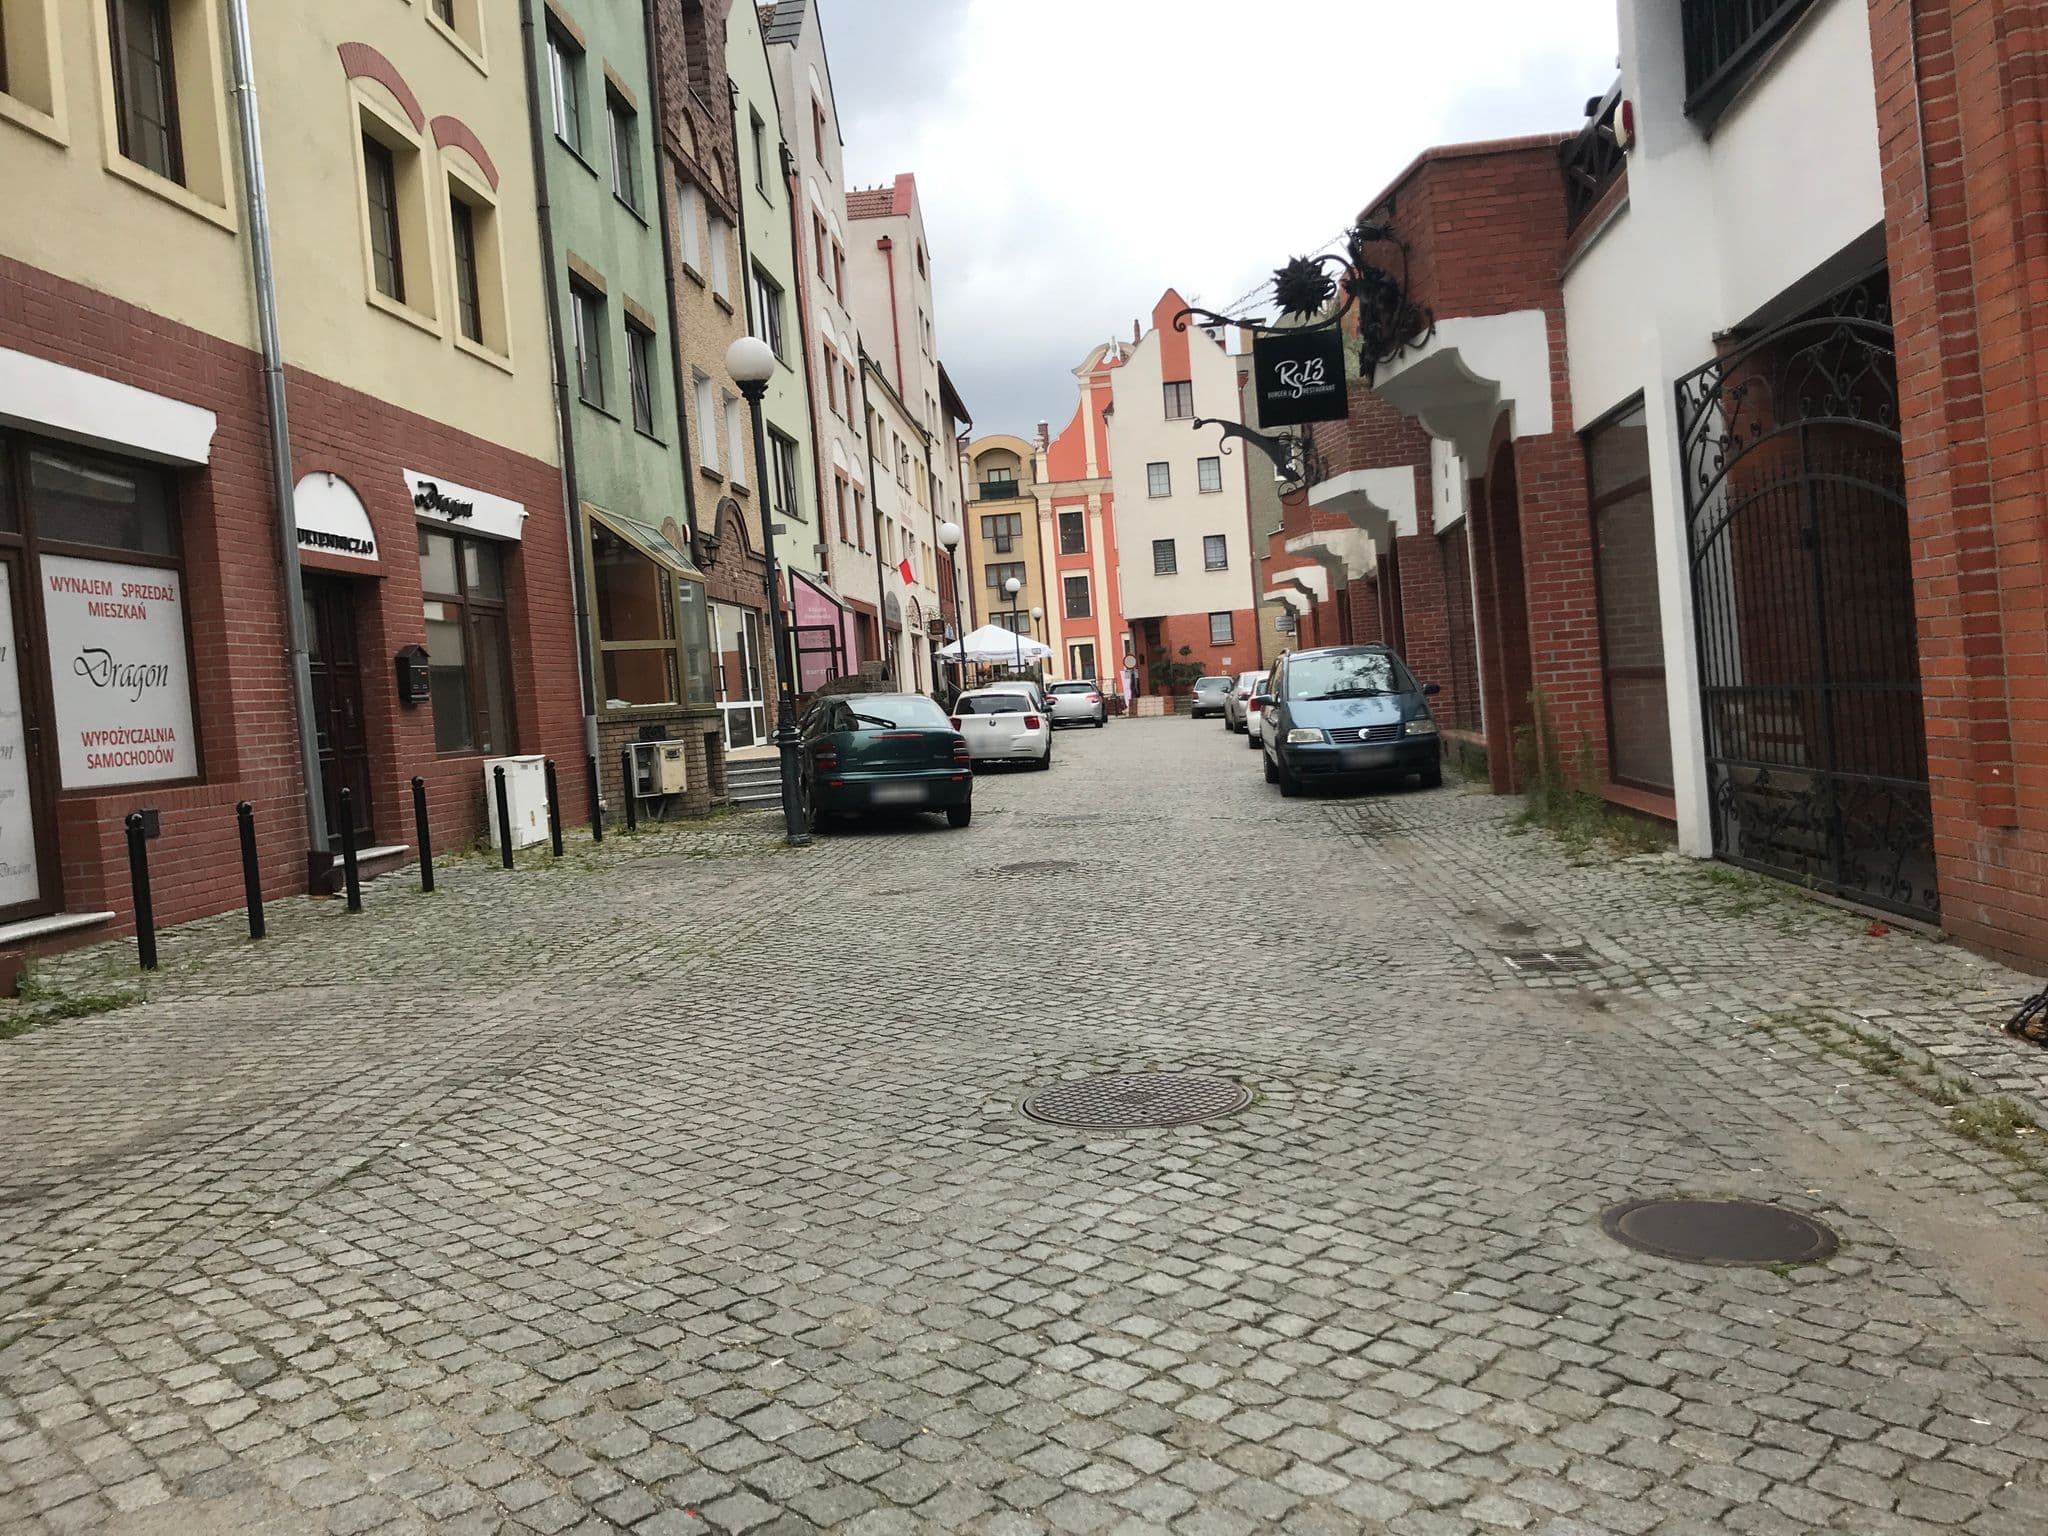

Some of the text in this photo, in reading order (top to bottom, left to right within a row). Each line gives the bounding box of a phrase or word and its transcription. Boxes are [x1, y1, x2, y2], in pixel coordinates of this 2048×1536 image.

[50, 575, 175, 602] WYNAJEM SPRZEDAŻ
[88, 602, 147, 620] MIESZKAŃ
[73, 645, 169, 703] Dragon
[81, 726, 176, 747] WYPOŻYCZALNIA
[87, 746, 175, 769] SAMOCHODÓW
